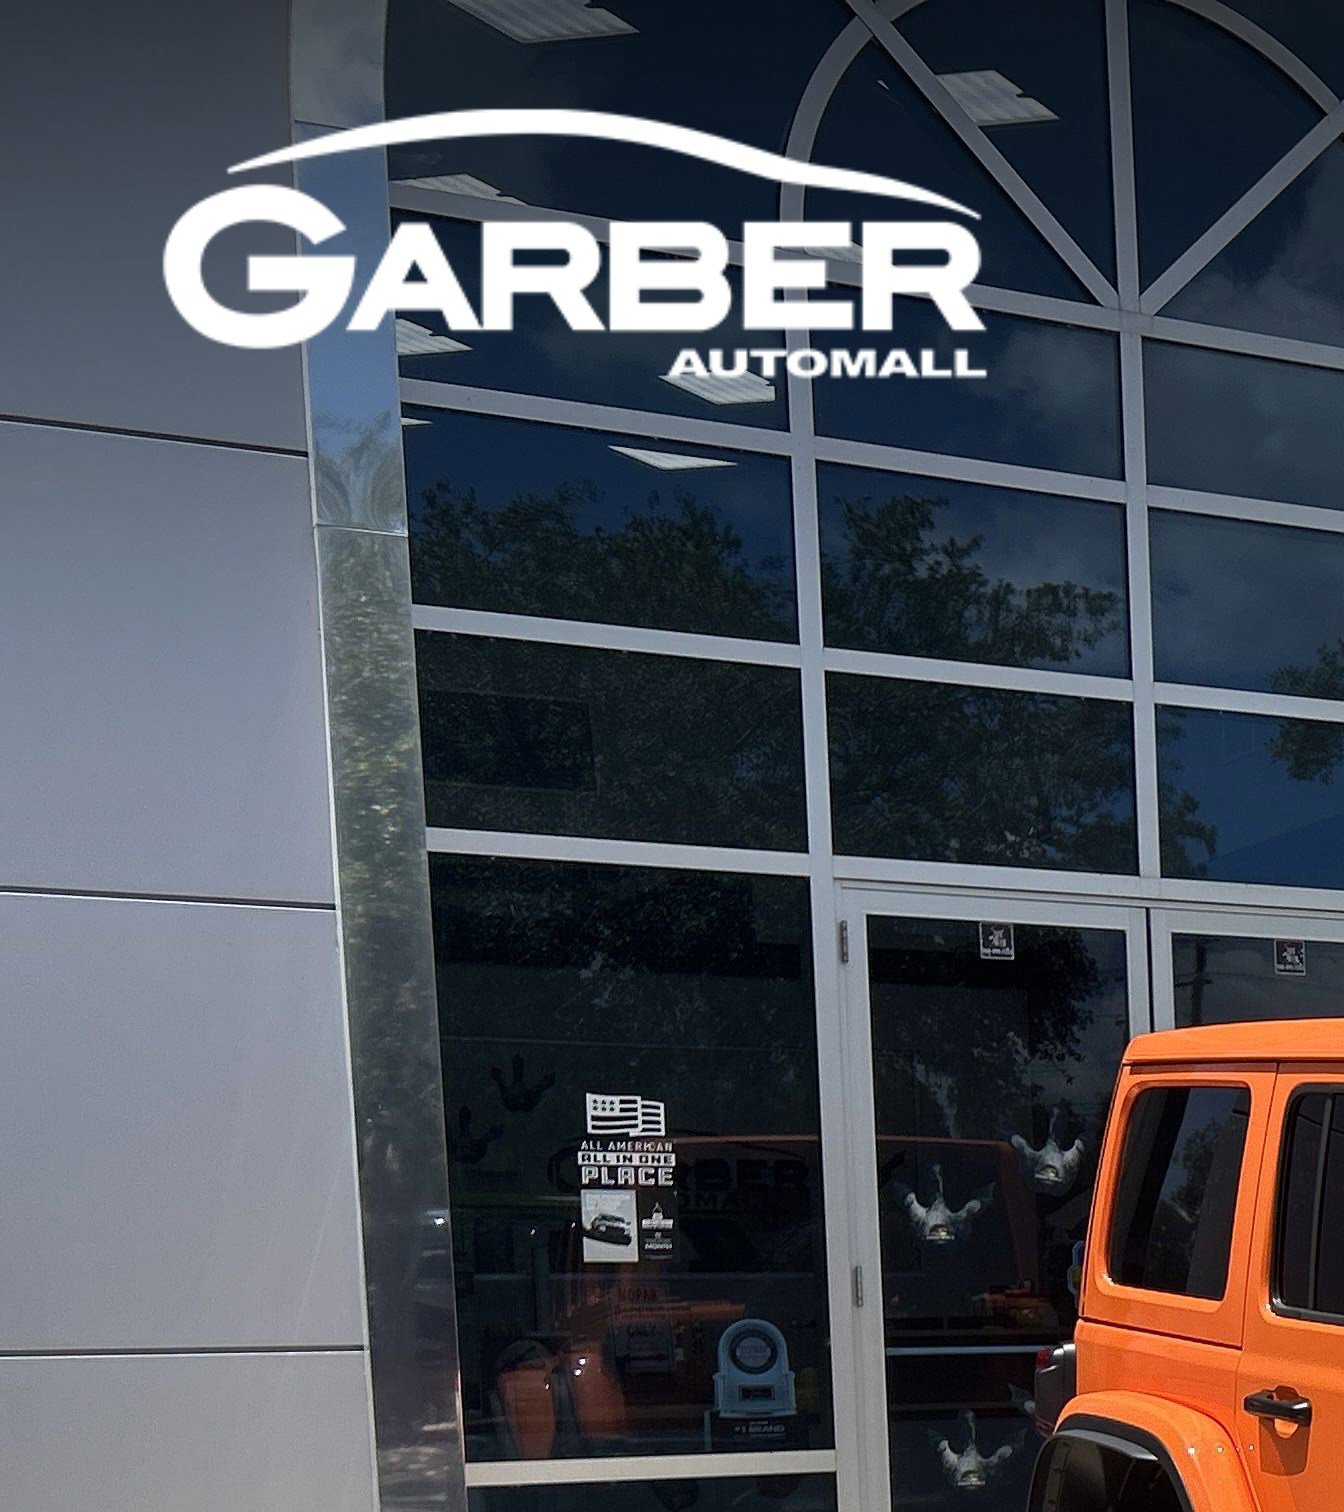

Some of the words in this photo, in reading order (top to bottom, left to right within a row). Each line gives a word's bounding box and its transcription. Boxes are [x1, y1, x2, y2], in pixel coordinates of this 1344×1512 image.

[580, 1140, 602, 1151] ALL
[607, 1141, 673, 1152] AMERICAN
[581, 1153, 611, 1164] ALL
[616, 1153, 633, 1164] IN
[638, 1153, 674, 1165] ONE
[581, 1166, 674, 1186] PLACE
